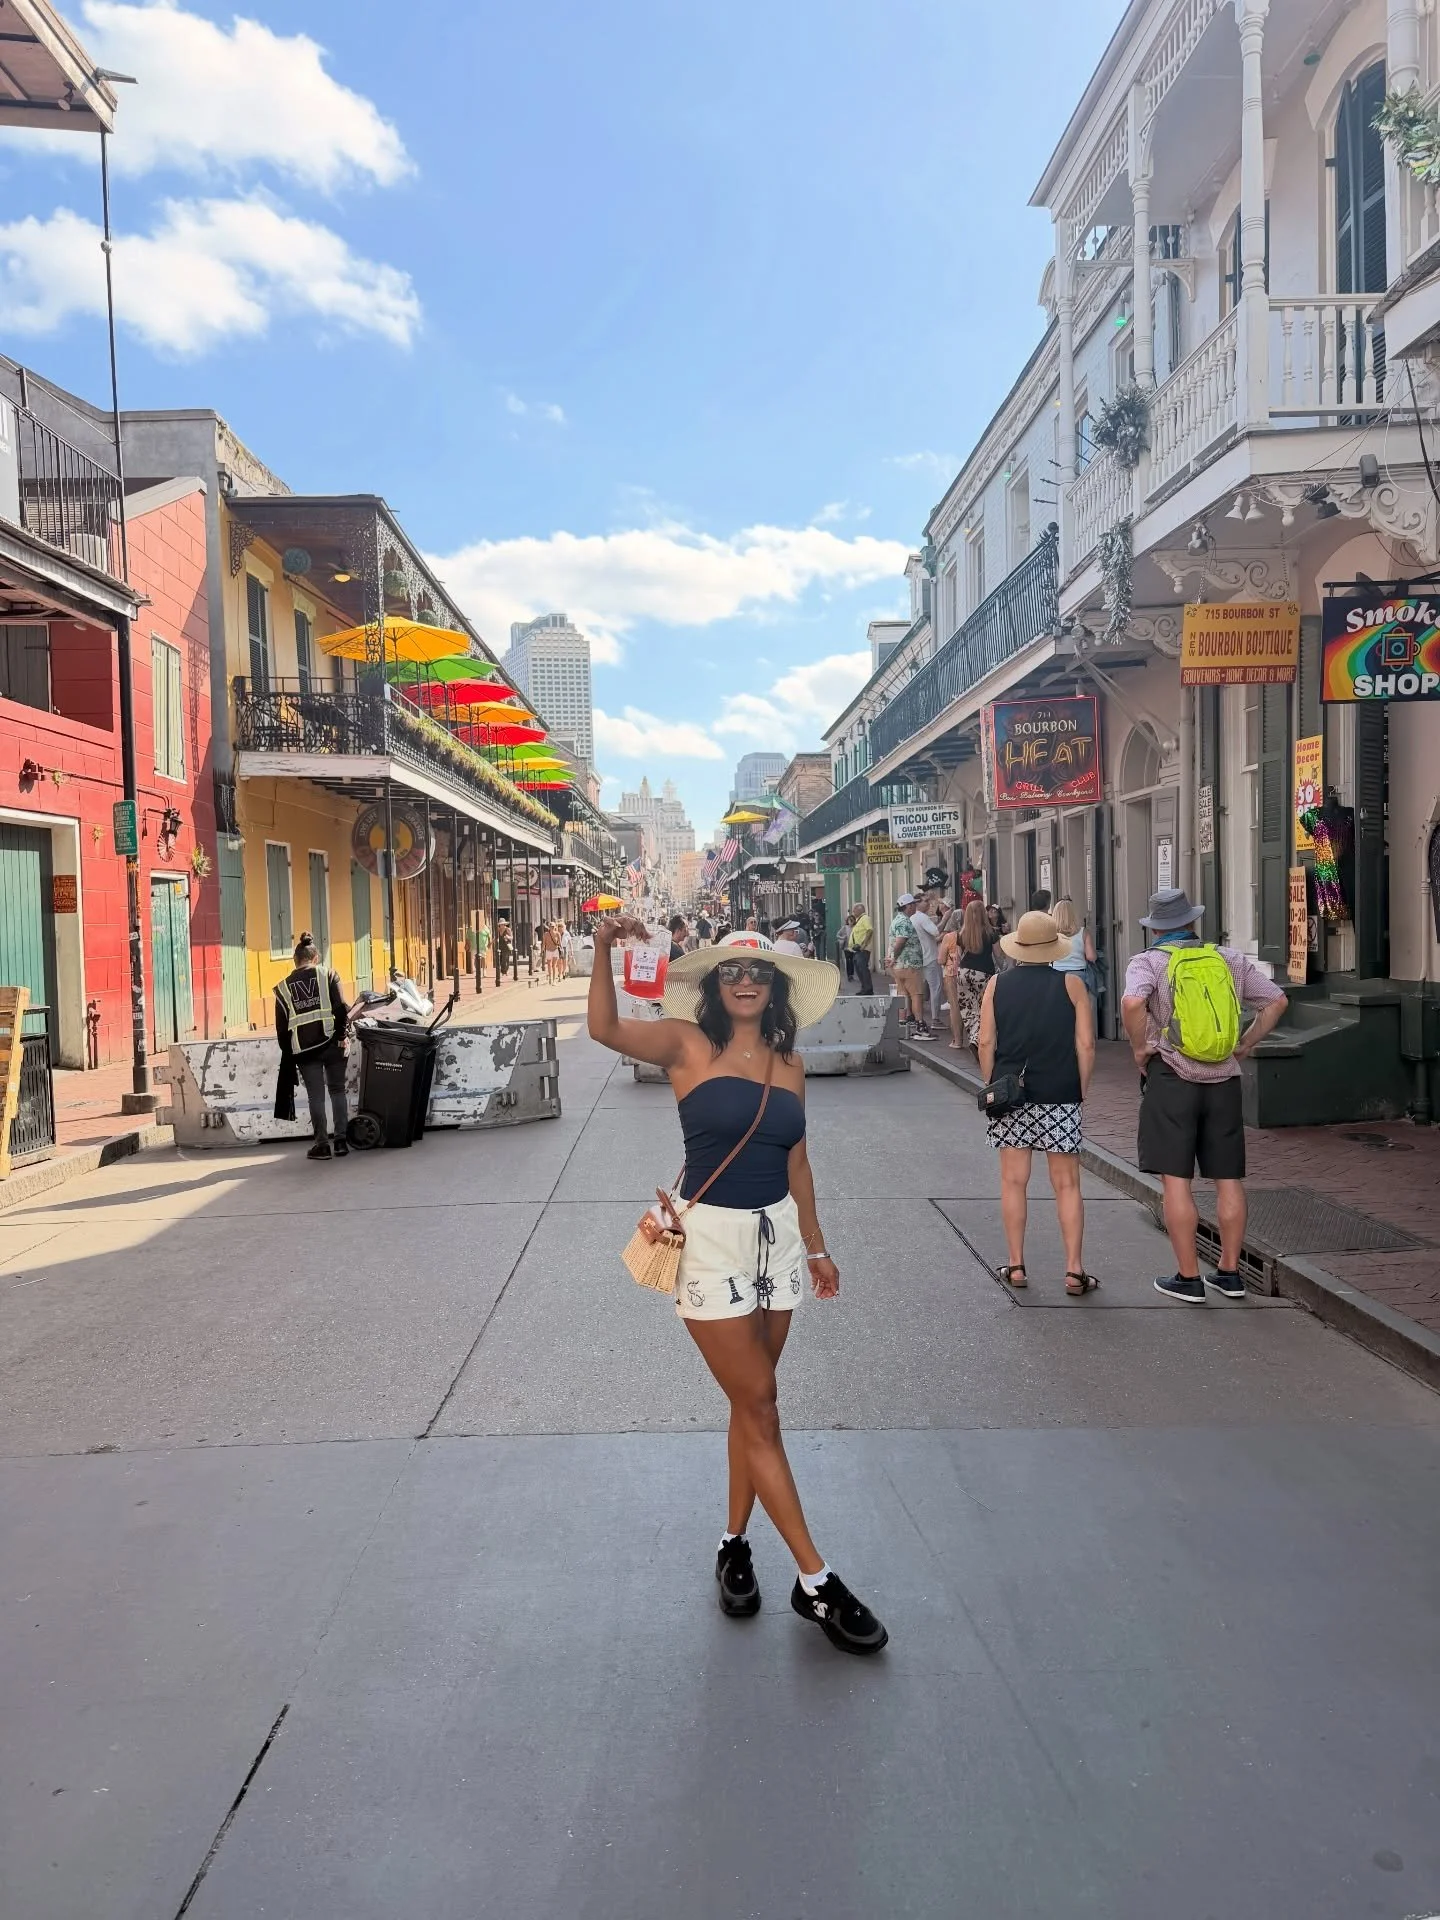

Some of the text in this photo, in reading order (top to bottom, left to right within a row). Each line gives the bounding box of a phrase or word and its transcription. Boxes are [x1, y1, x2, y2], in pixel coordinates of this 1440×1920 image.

[1205, 608, 1280, 619] 715 BOURBON ST
[1188, 630, 1293, 656] NEW BOURBON BOUTIQUE
[1183, 668, 1220, 683] SOUVENIRS
[1226, 668, 1244, 682] HOME
[1246, 668, 1267, 682] DECOR
[1276, 667, 1295, 681] MORE
[1353, 672, 1440, 697] SHOP
[1014, 719, 1077, 735] BOURBON
[1005, 737, 1092, 770] HEAT
[1296, 740, 1320, 753] Home
[1296, 752, 1320, 764] Decor
[1015, 781, 1045, 793] GRILL
[1071, 771, 1096, 788] CLUB
[893, 811, 959, 825] TRICOU GIFTS
[902, 823, 951, 832] GUARANTEED
